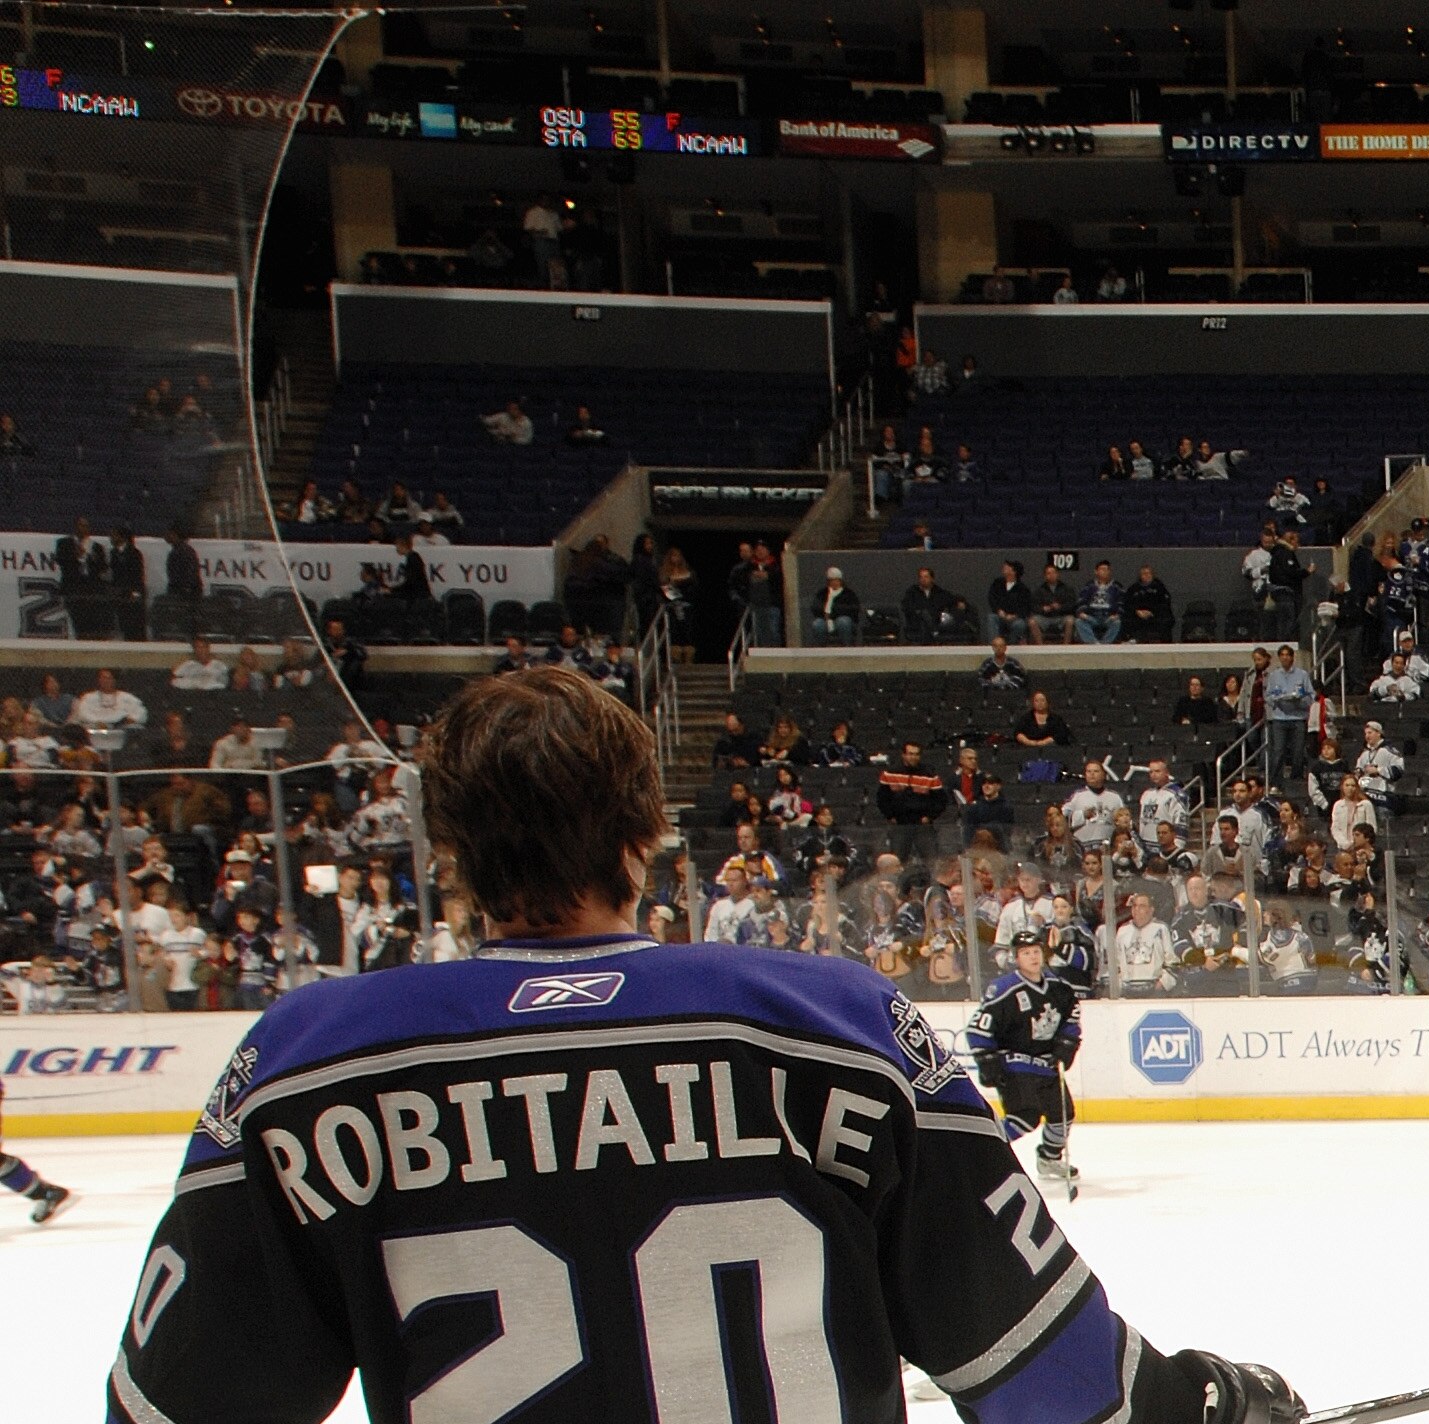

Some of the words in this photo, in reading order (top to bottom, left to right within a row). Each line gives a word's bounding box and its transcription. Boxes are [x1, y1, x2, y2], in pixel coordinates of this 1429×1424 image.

[46, 69, 63, 86] F
[60, 91, 140, 118] NCAAW
[228, 96, 346, 126] TOYOTA
[541, 106, 586, 128] OSU
[610, 109, 641, 132] 55
[666, 112, 682, 131] F
[779, 119, 818, 136] Bank
[819, 121, 834, 137] of
[834, 123, 898, 141] America
[541, 127, 588, 149] STA
[611, 131, 643, 151] 69
[677, 134, 748, 155] NCAAW
[1201, 135, 1310, 150] DIRECTV
[1325, 135, 1359, 150] THE
[1362, 135, 1408, 150] HOME
[198, 560, 268, 582] HANK
[458, 563, 508, 584] YOU
[17, 576, 70, 638] 2
[968, 1012, 992, 1030] 20
[3, 1044, 180, 1075] IGHT
[1142, 1032, 1190, 1061] ADT
[1215, 1029, 1293, 1060] ADT
[1300, 1027, 1401, 1067] Always
